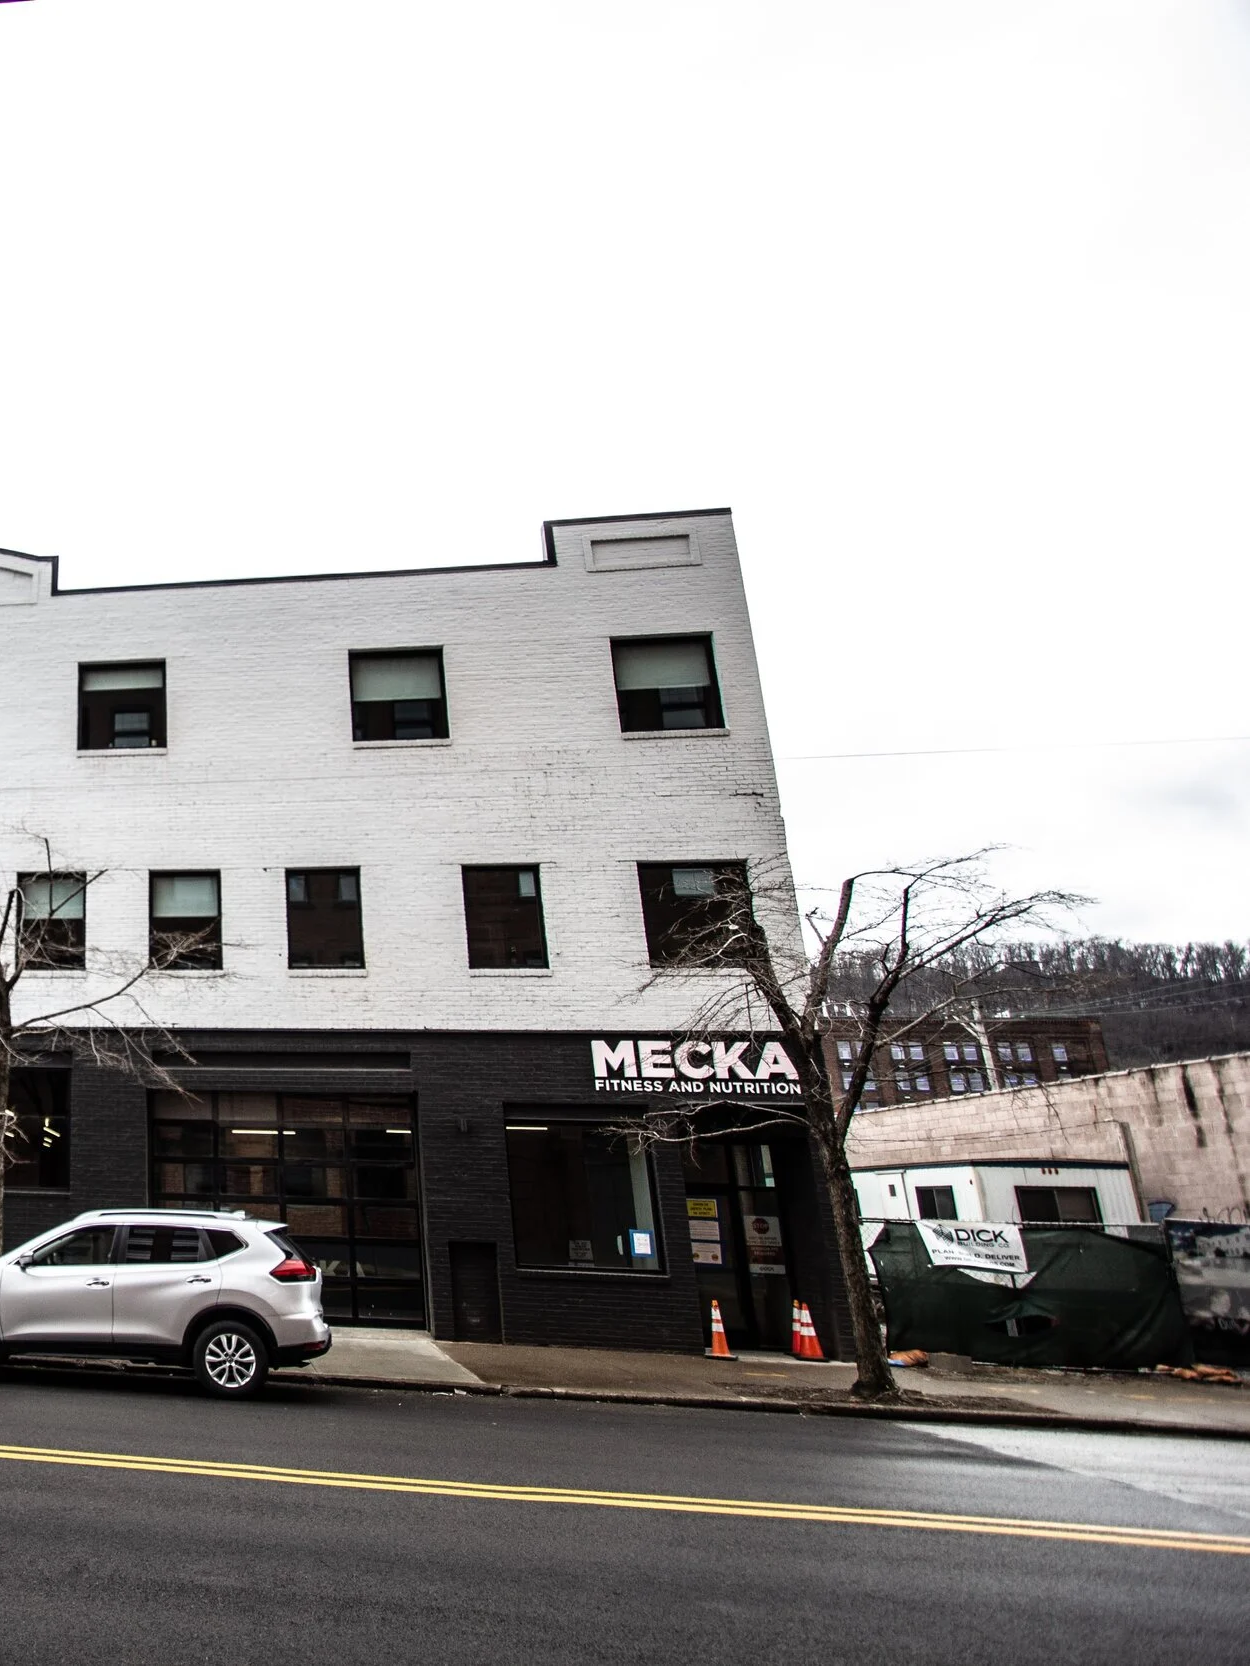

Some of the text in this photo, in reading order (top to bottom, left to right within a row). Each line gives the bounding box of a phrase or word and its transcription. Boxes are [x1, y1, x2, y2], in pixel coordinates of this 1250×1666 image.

[591, 1040, 799, 1080] MECKA
[595, 1079, 802, 1095] FITNESS AND NUTRITION
[955, 1229, 1009, 1243] DICK
